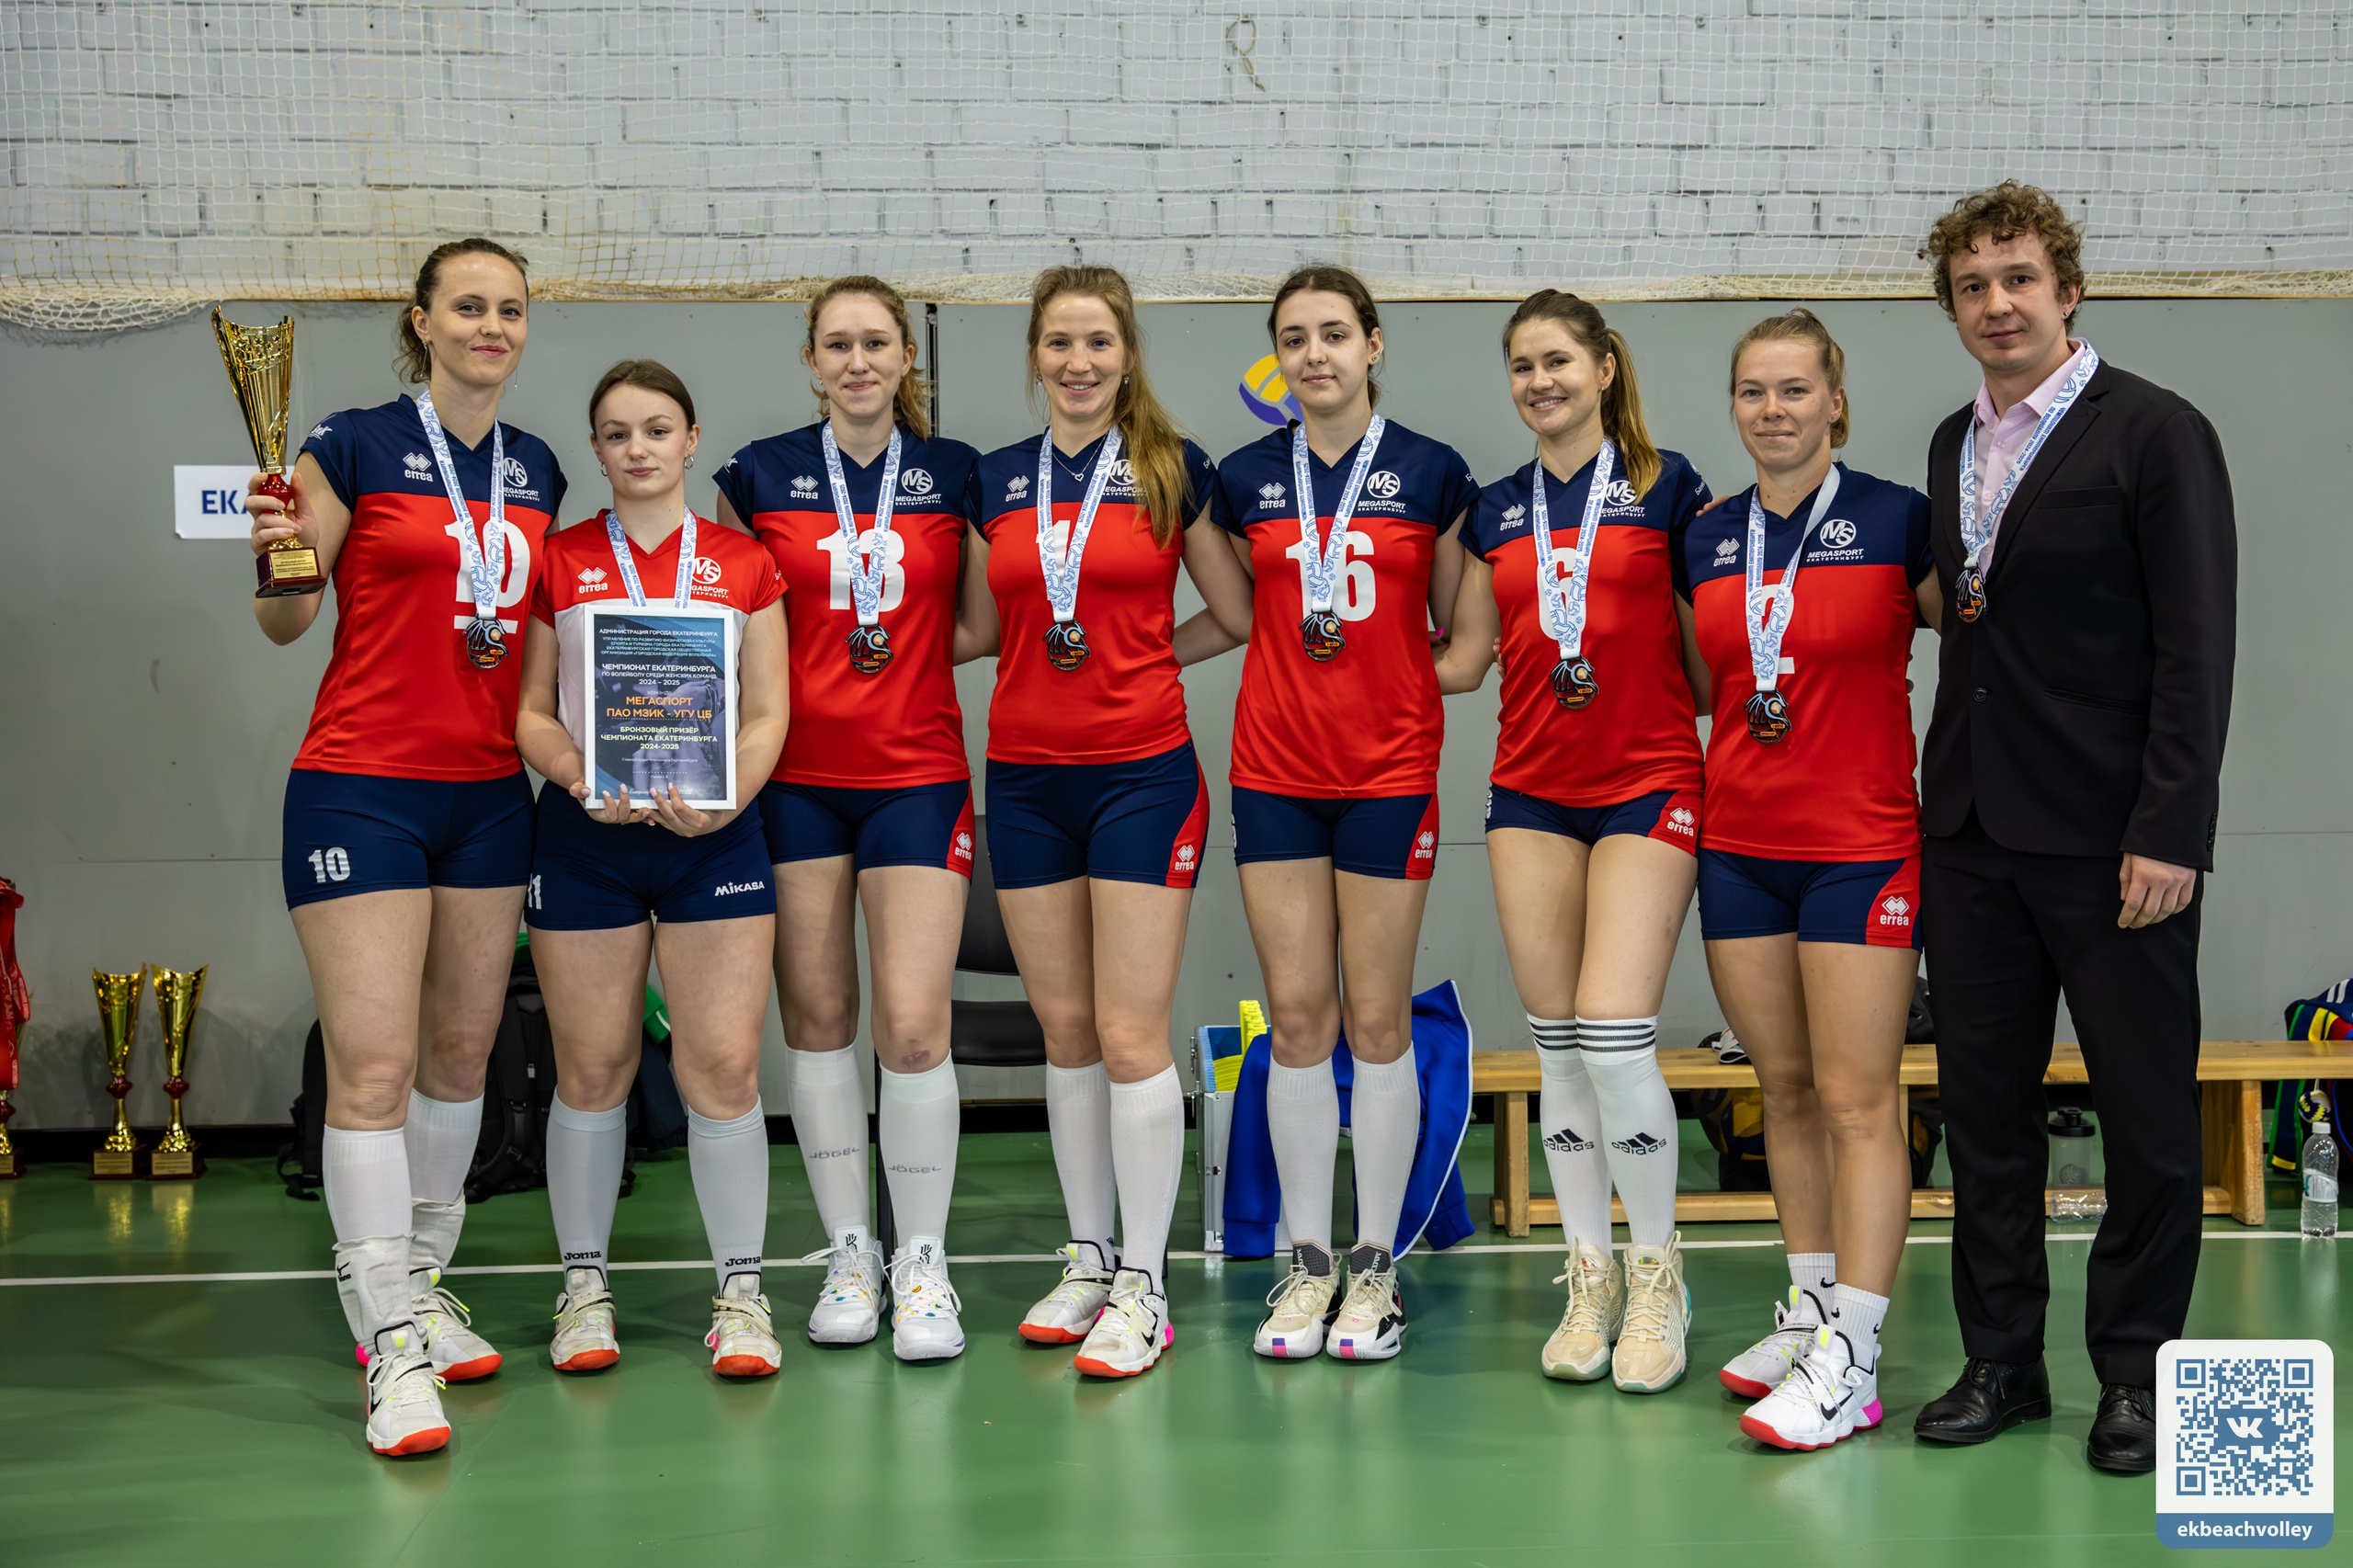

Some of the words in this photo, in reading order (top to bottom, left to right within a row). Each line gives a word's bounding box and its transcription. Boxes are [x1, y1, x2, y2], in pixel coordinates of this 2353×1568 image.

[2033, 414, 2051, 439] ВОЛЕЙБОЛУ
[2044, 408, 2065, 434] ЧЕМПИОНАТ
[2017, 441, 2034, 464] 2024-2025
[2020, 434, 2045, 471] ЕКАТЕРИНБУРГА
[404, 469, 433, 483] errea
[504, 458, 527, 486] MS
[904, 470, 931, 493] MS
[1370, 472, 1398, 495] MS
[504, 487, 540, 497] EGASPORT
[790, 490, 819, 500] errea
[895, 494, 941, 502] MEGASPORT
[1006, 489, 1028, 502] errea
[1607, 483, 1636, 504] MS
[1259, 498, 1286, 509] errea
[1358, 500, 1406, 509] MEGASPORT
[1499, 517, 1524, 531] errea
[1822, 521, 1855, 545] MS
[1807, 548, 1864, 558] MEGASPORT
[444, 518, 530, 608] 10
[1713, 554, 1737, 567] errea
[694, 559, 720, 582] MS
[1285, 530, 1376, 622] 16
[578, 583, 608, 594] errea
[691, 585, 729, 595] GASPORT
[1536, 547, 1586, 641] 6
[602, 663, 651, 671] ЧЕМПИОНАТ
[652, 664, 716, 673] ЕКАТЕРИНБУРГА
[626, 696, 694, 706] МЕГАСПОРТ
[607, 708, 631, 717] ПАО
[633, 709, 665, 718] МЗИК
[673, 709, 696, 718] УГУ
[697, 710, 712, 720] ЦБ
[620, 725, 668, 733] БРОНЗОВЫЙ
[654, 734, 718, 743] ЕКАТЕРИНБУРГА
[1667, 821, 1694, 837] errea
[955, 846, 972, 860] errea
[1415, 847, 1433, 859] errea
[308, 846, 351, 882] 10
[1175, 860, 1195, 871] errea
[1880, 914, 1909, 926] errea
[809, 1147, 860, 1159] JÖGEL
[1543, 1140, 1595, 1153] adidas
[1611, 1139, 1666, 1155] adidas
[889, 1165, 941, 1174] JÖGEL
[563, 1251, 602, 1261] Joma
[724, 1256, 761, 1267] Joma
